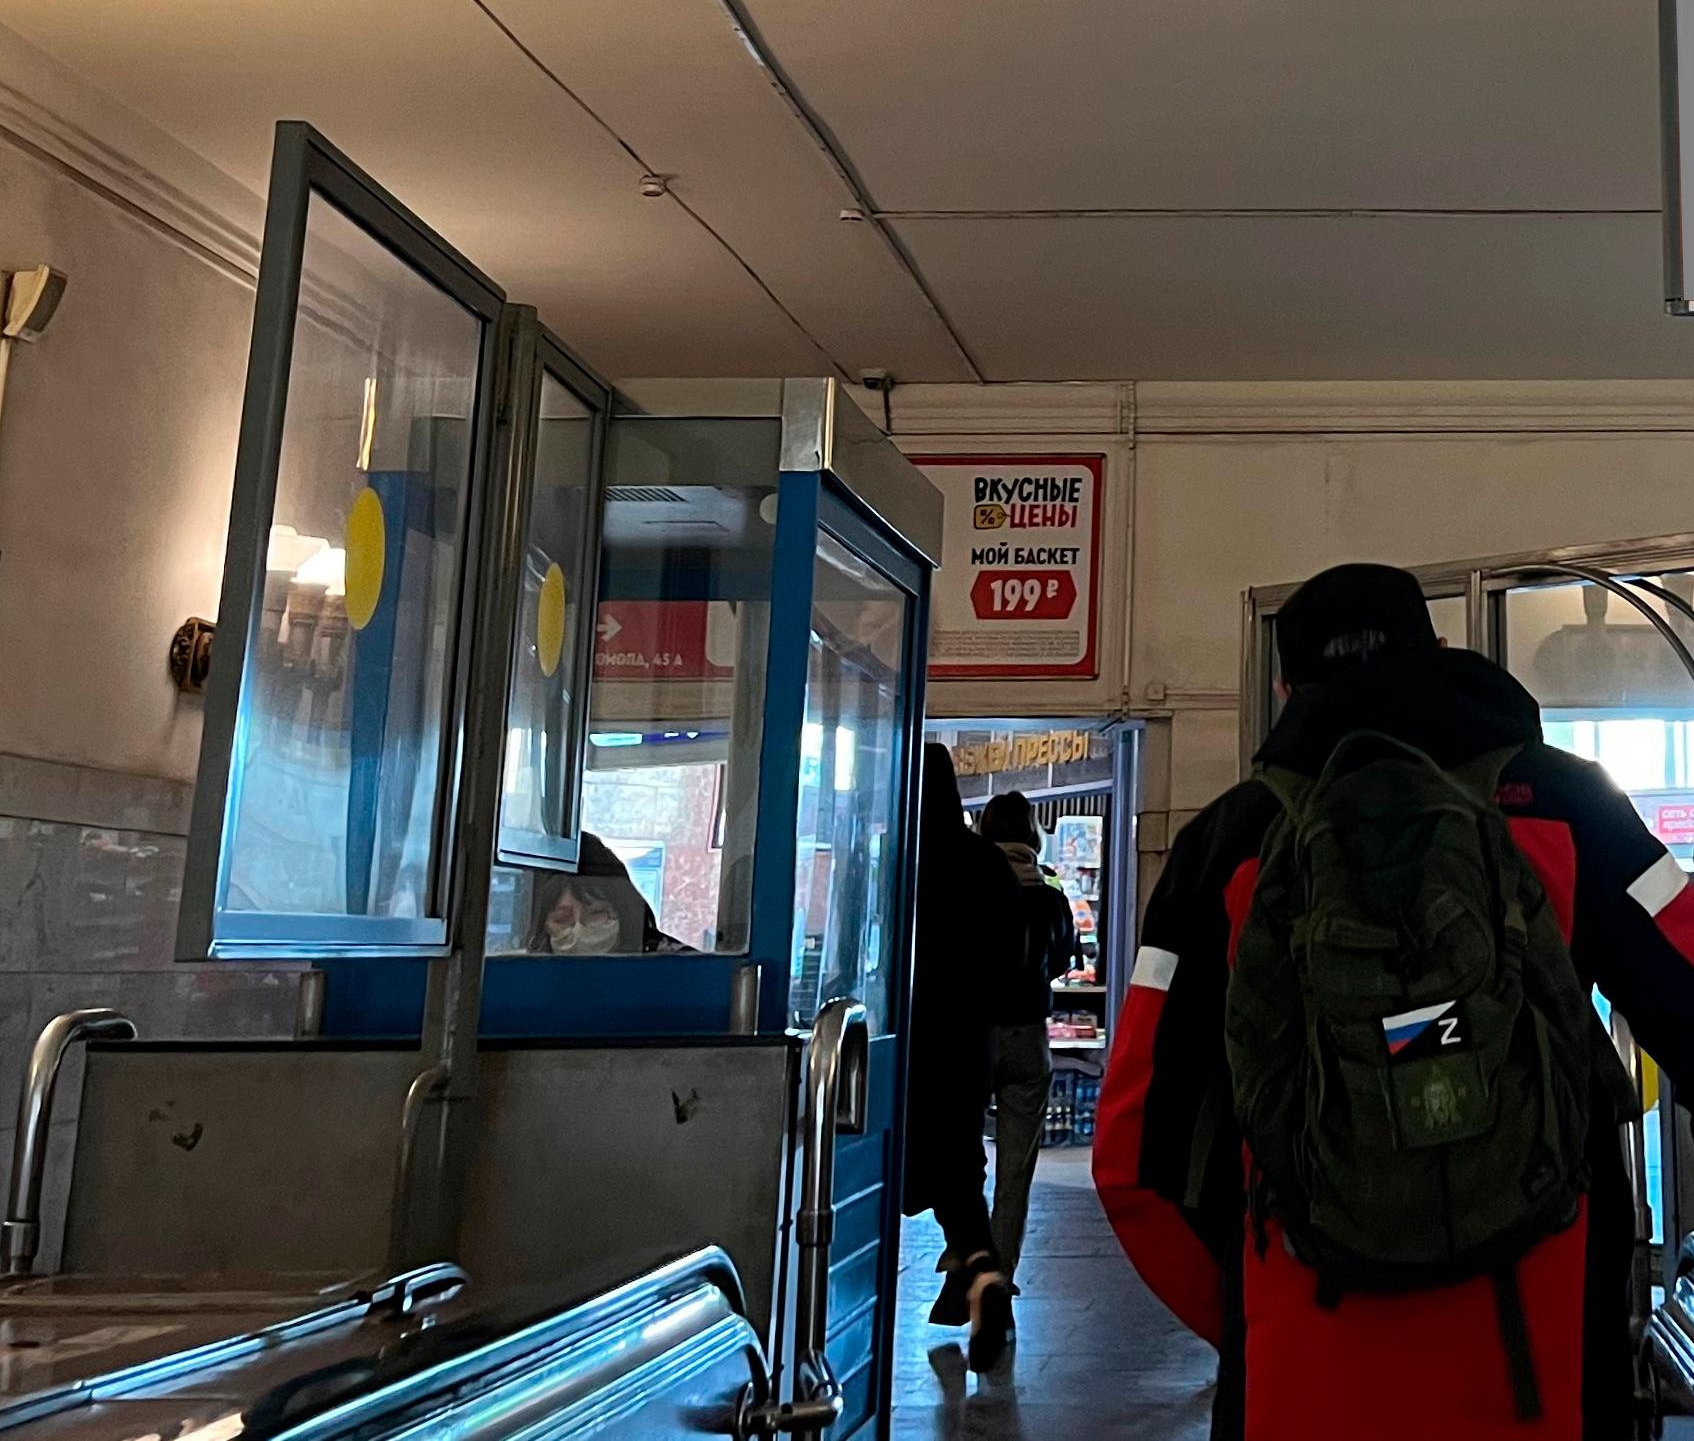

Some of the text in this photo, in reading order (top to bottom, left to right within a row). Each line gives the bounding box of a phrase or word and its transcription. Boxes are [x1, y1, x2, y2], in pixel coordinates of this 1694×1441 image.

[974, 477, 1083, 504] ВКУСНЫЕ
[1009, 502, 1078, 529] ЦЕНЫ
[971, 541, 1080, 565] МОЙ БАСКЕТ
[990, 578, 1042, 612] 199
[1438, 1017, 1462, 1045] Z
